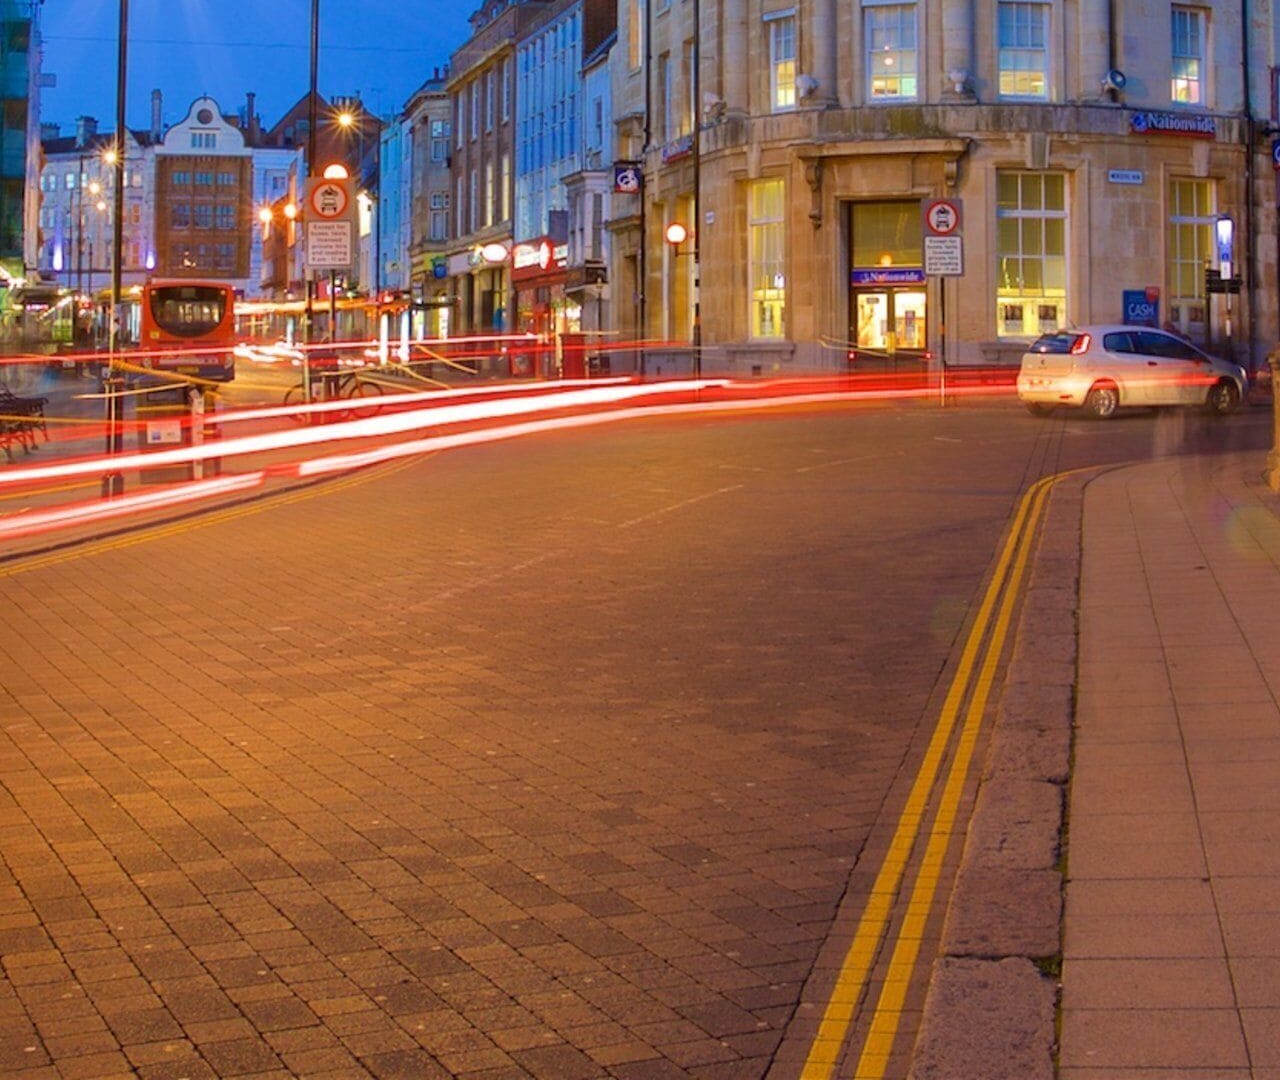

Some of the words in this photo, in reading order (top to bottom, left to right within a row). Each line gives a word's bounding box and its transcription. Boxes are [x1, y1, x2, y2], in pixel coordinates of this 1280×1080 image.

[1147, 111, 1215, 133] Nationwide
[869, 271, 920, 282] Nationwide
[1128, 303, 1155, 317] CASH
